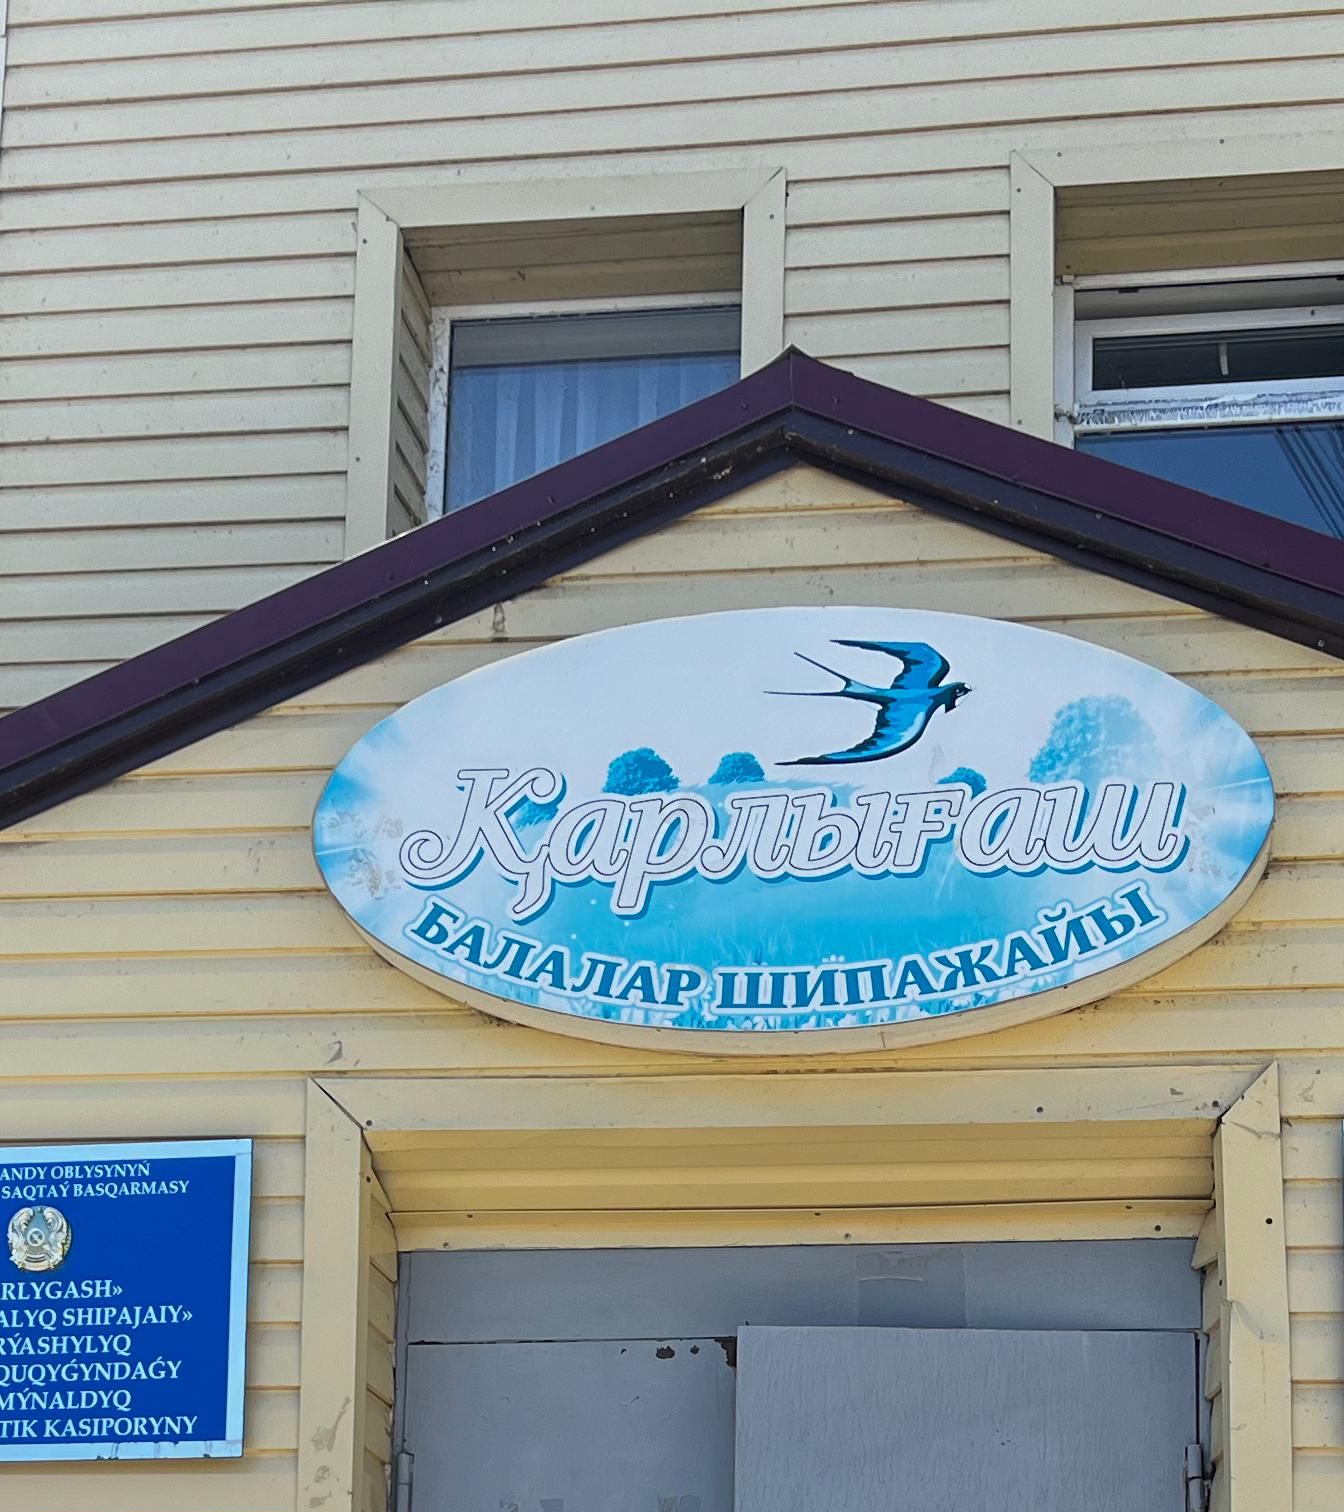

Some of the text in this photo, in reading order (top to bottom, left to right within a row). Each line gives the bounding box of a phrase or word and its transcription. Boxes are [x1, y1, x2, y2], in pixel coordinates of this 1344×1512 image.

[398, 766, 1190, 924] Қарлығаш
[409, 885, 1161, 1010] БАЛАЛАР ШИПАЖАЙЫ
[2, 1181, 69, 1200] SAQTAÝ
[74, 1181, 189, 1198] BASQARMASY
[62, 1305, 192, 1329] SHIPAJAIY»
[43, 1416, 197, 1438] KASIPORYNY
